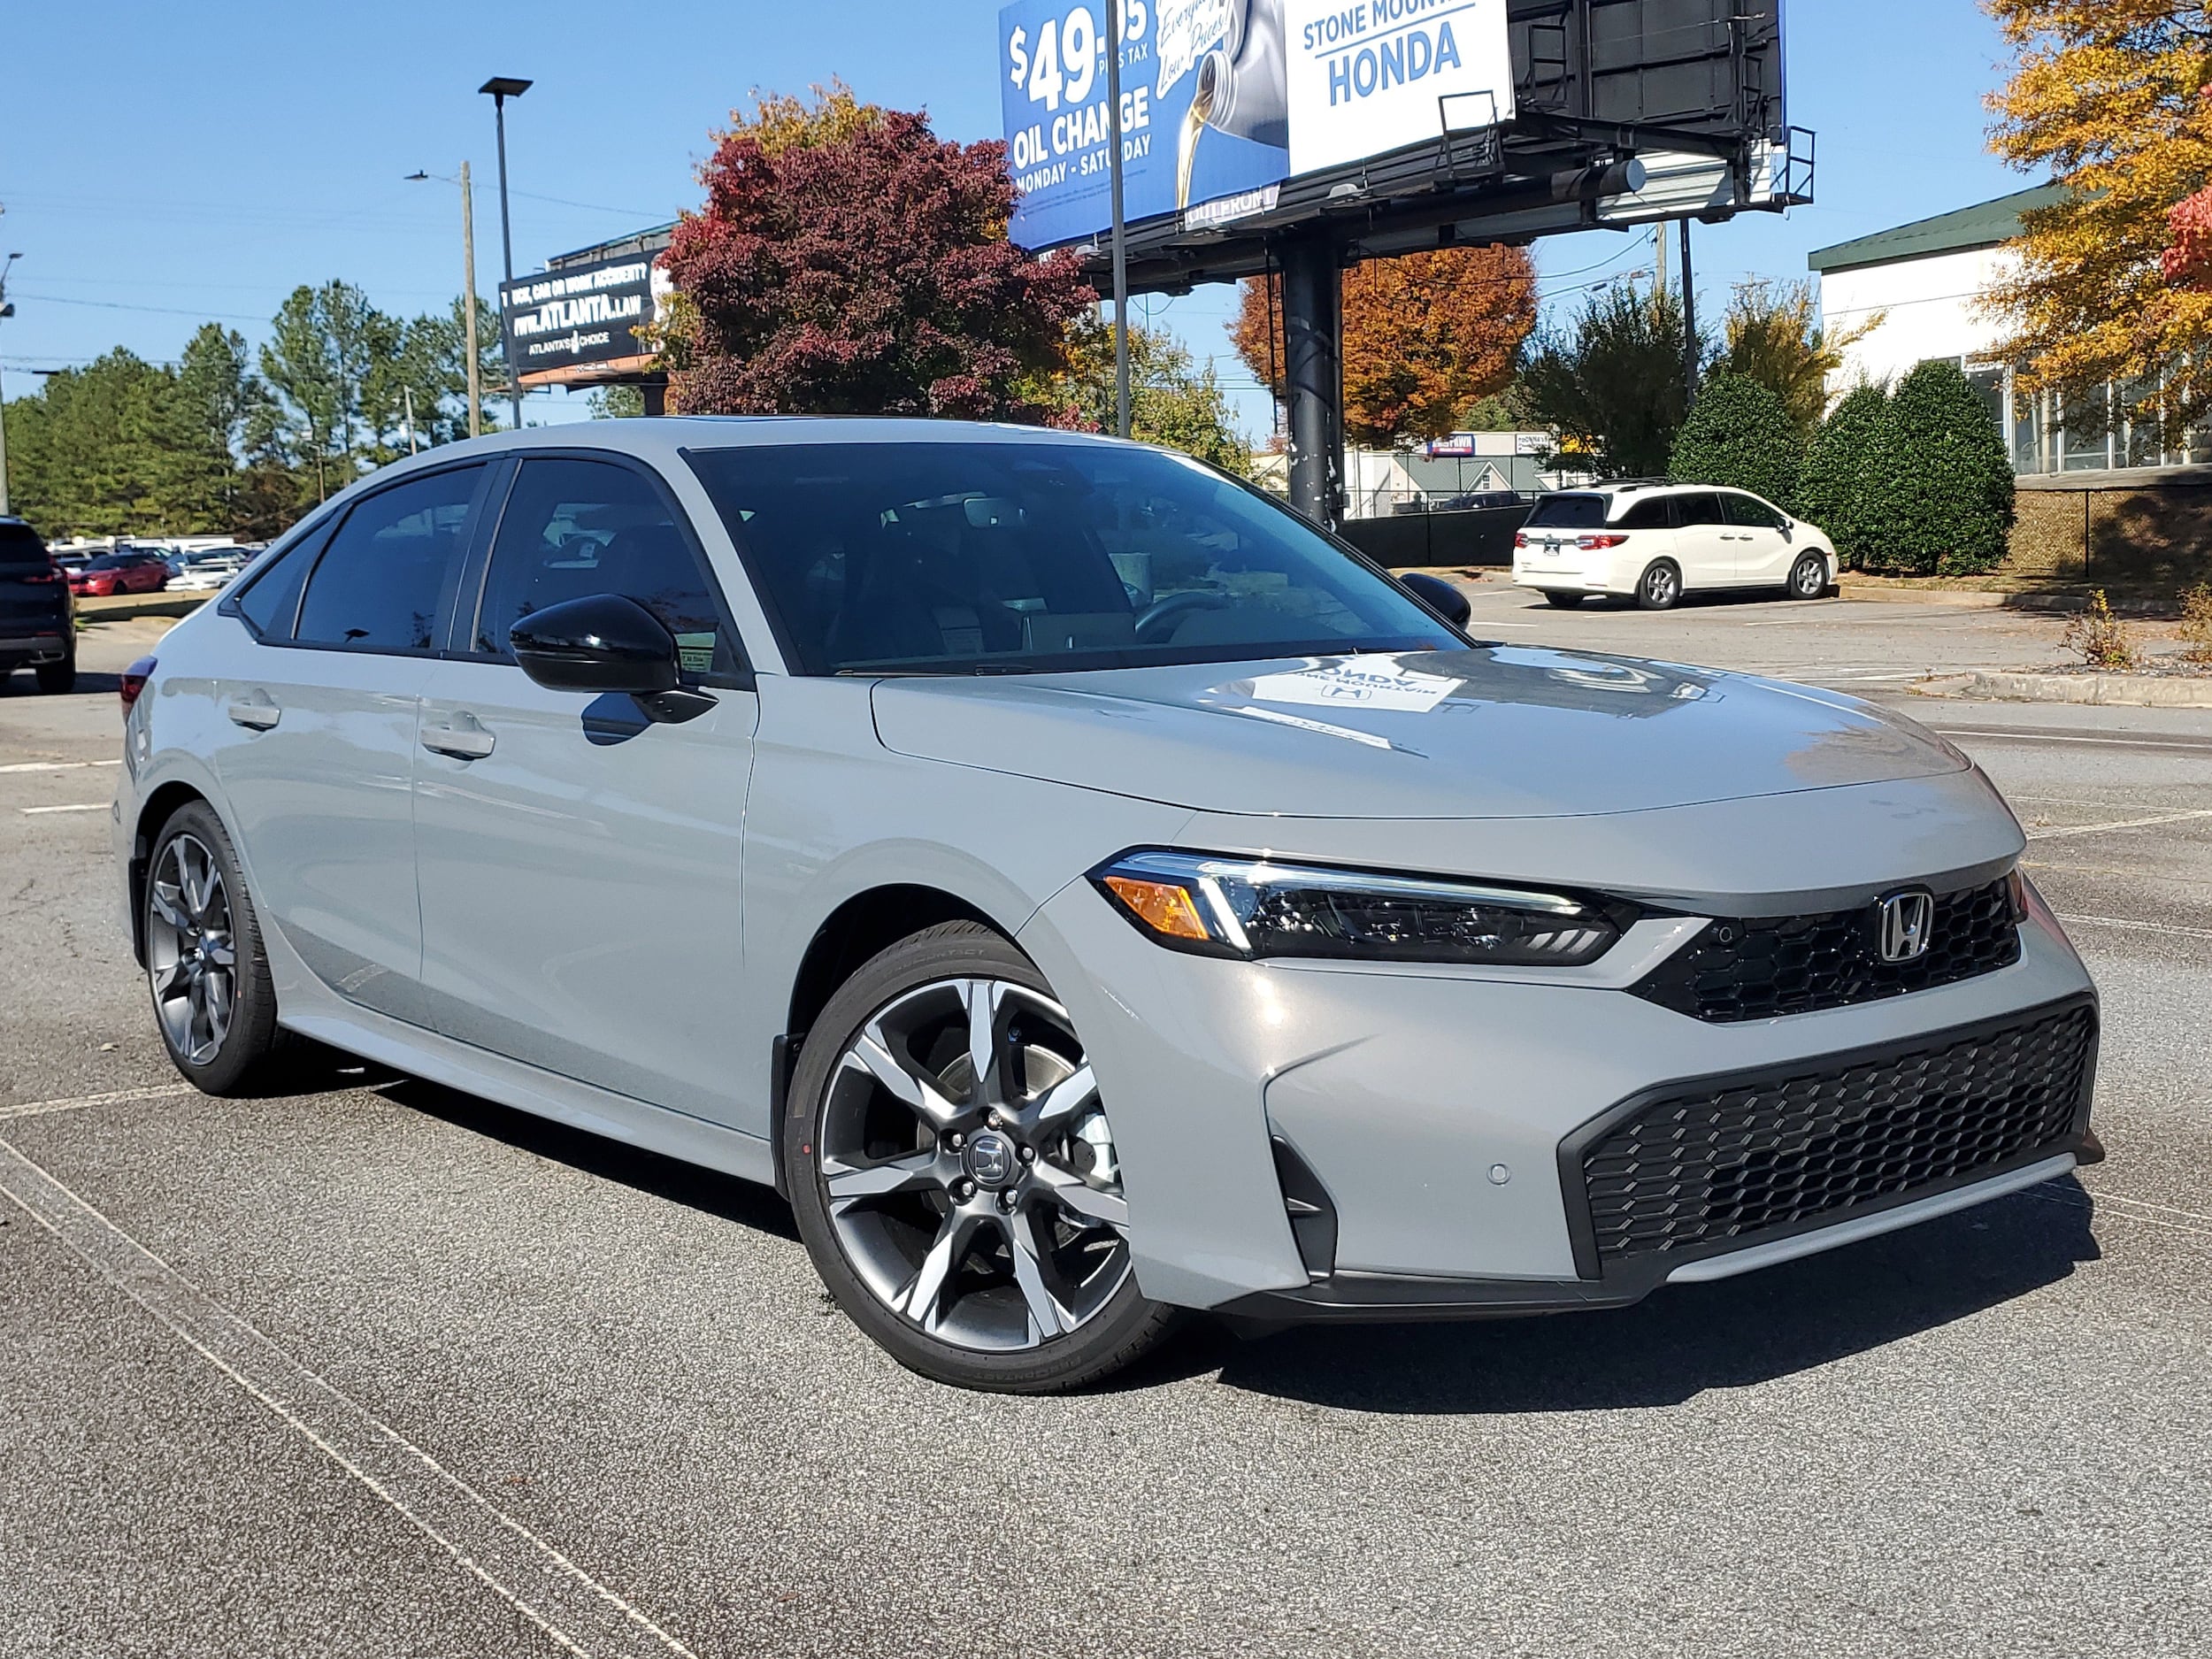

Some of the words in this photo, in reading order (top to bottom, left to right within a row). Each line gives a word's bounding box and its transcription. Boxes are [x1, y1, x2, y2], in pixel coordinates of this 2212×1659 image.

[1303, 4, 1366, 50] STONE
[1010, 0, 1148, 111] $49.5
[1099, 50, 1125, 76] PS
[1127, 42, 1148, 65] TAX
[1329, 20, 1462, 106] HONDA
[1013, 124, 1048, 170] OIL
[1016, 160, 1067, 194] MONDAY
[528, 337, 571, 356] ATLANTA'S
[579, 331, 611, 347] CHOICE
